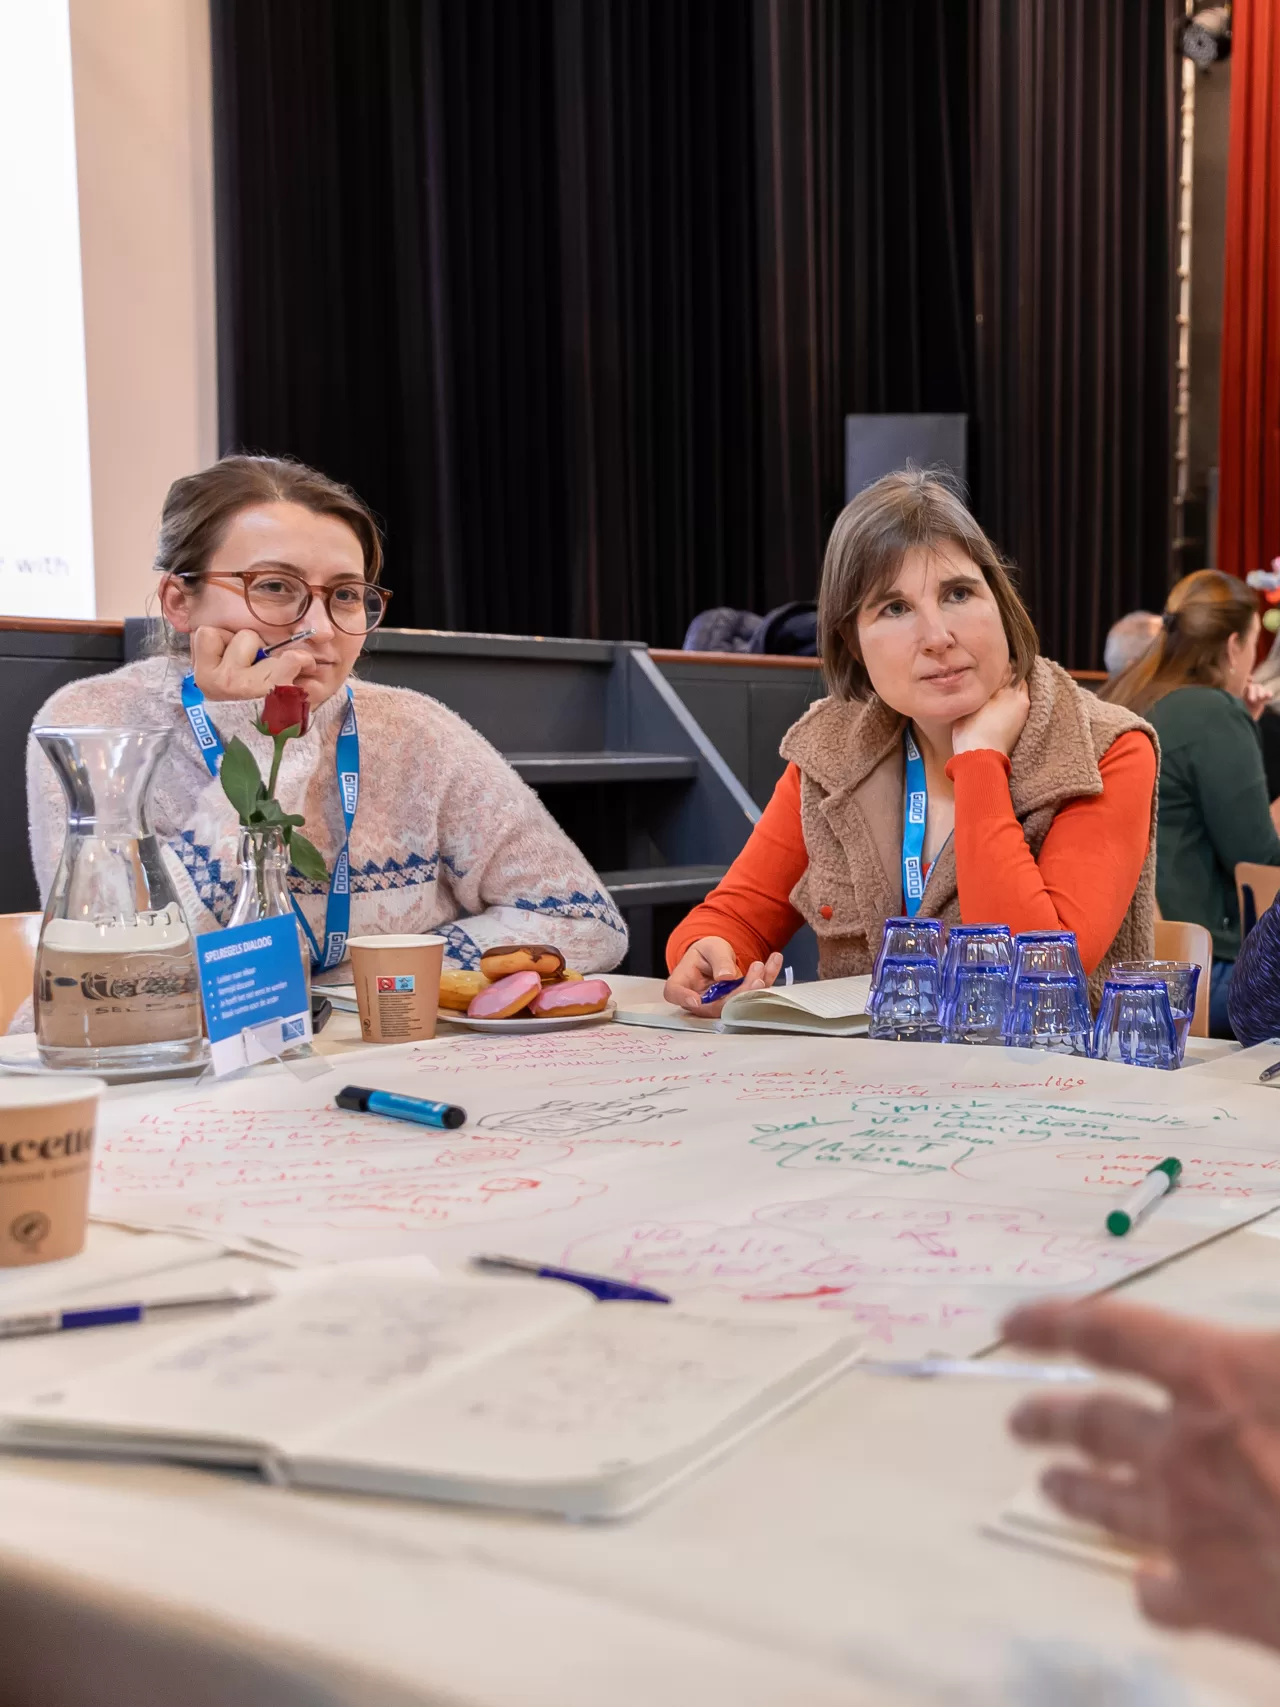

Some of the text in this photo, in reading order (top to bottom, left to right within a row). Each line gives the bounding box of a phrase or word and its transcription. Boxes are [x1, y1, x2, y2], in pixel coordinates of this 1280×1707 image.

[188, 706, 215, 748] G1000
[912, 793, 924, 822] G1000
[907, 859, 921, 897] G1000
